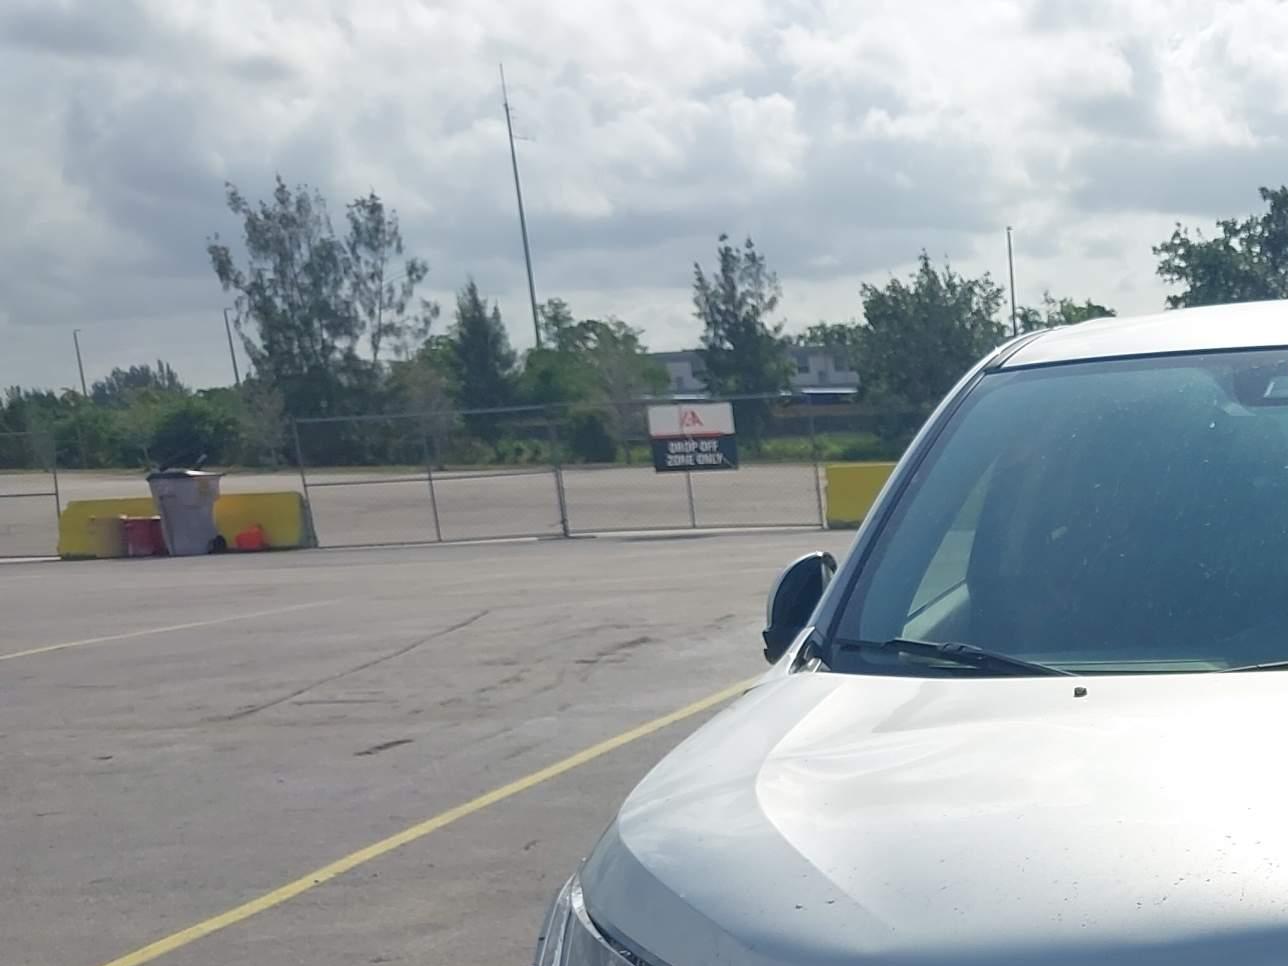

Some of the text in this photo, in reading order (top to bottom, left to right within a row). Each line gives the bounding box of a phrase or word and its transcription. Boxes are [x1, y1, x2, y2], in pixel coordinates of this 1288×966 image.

[669, 441, 718, 453] DROP OFF
[667, 453, 723, 466] ZONE ONLY
